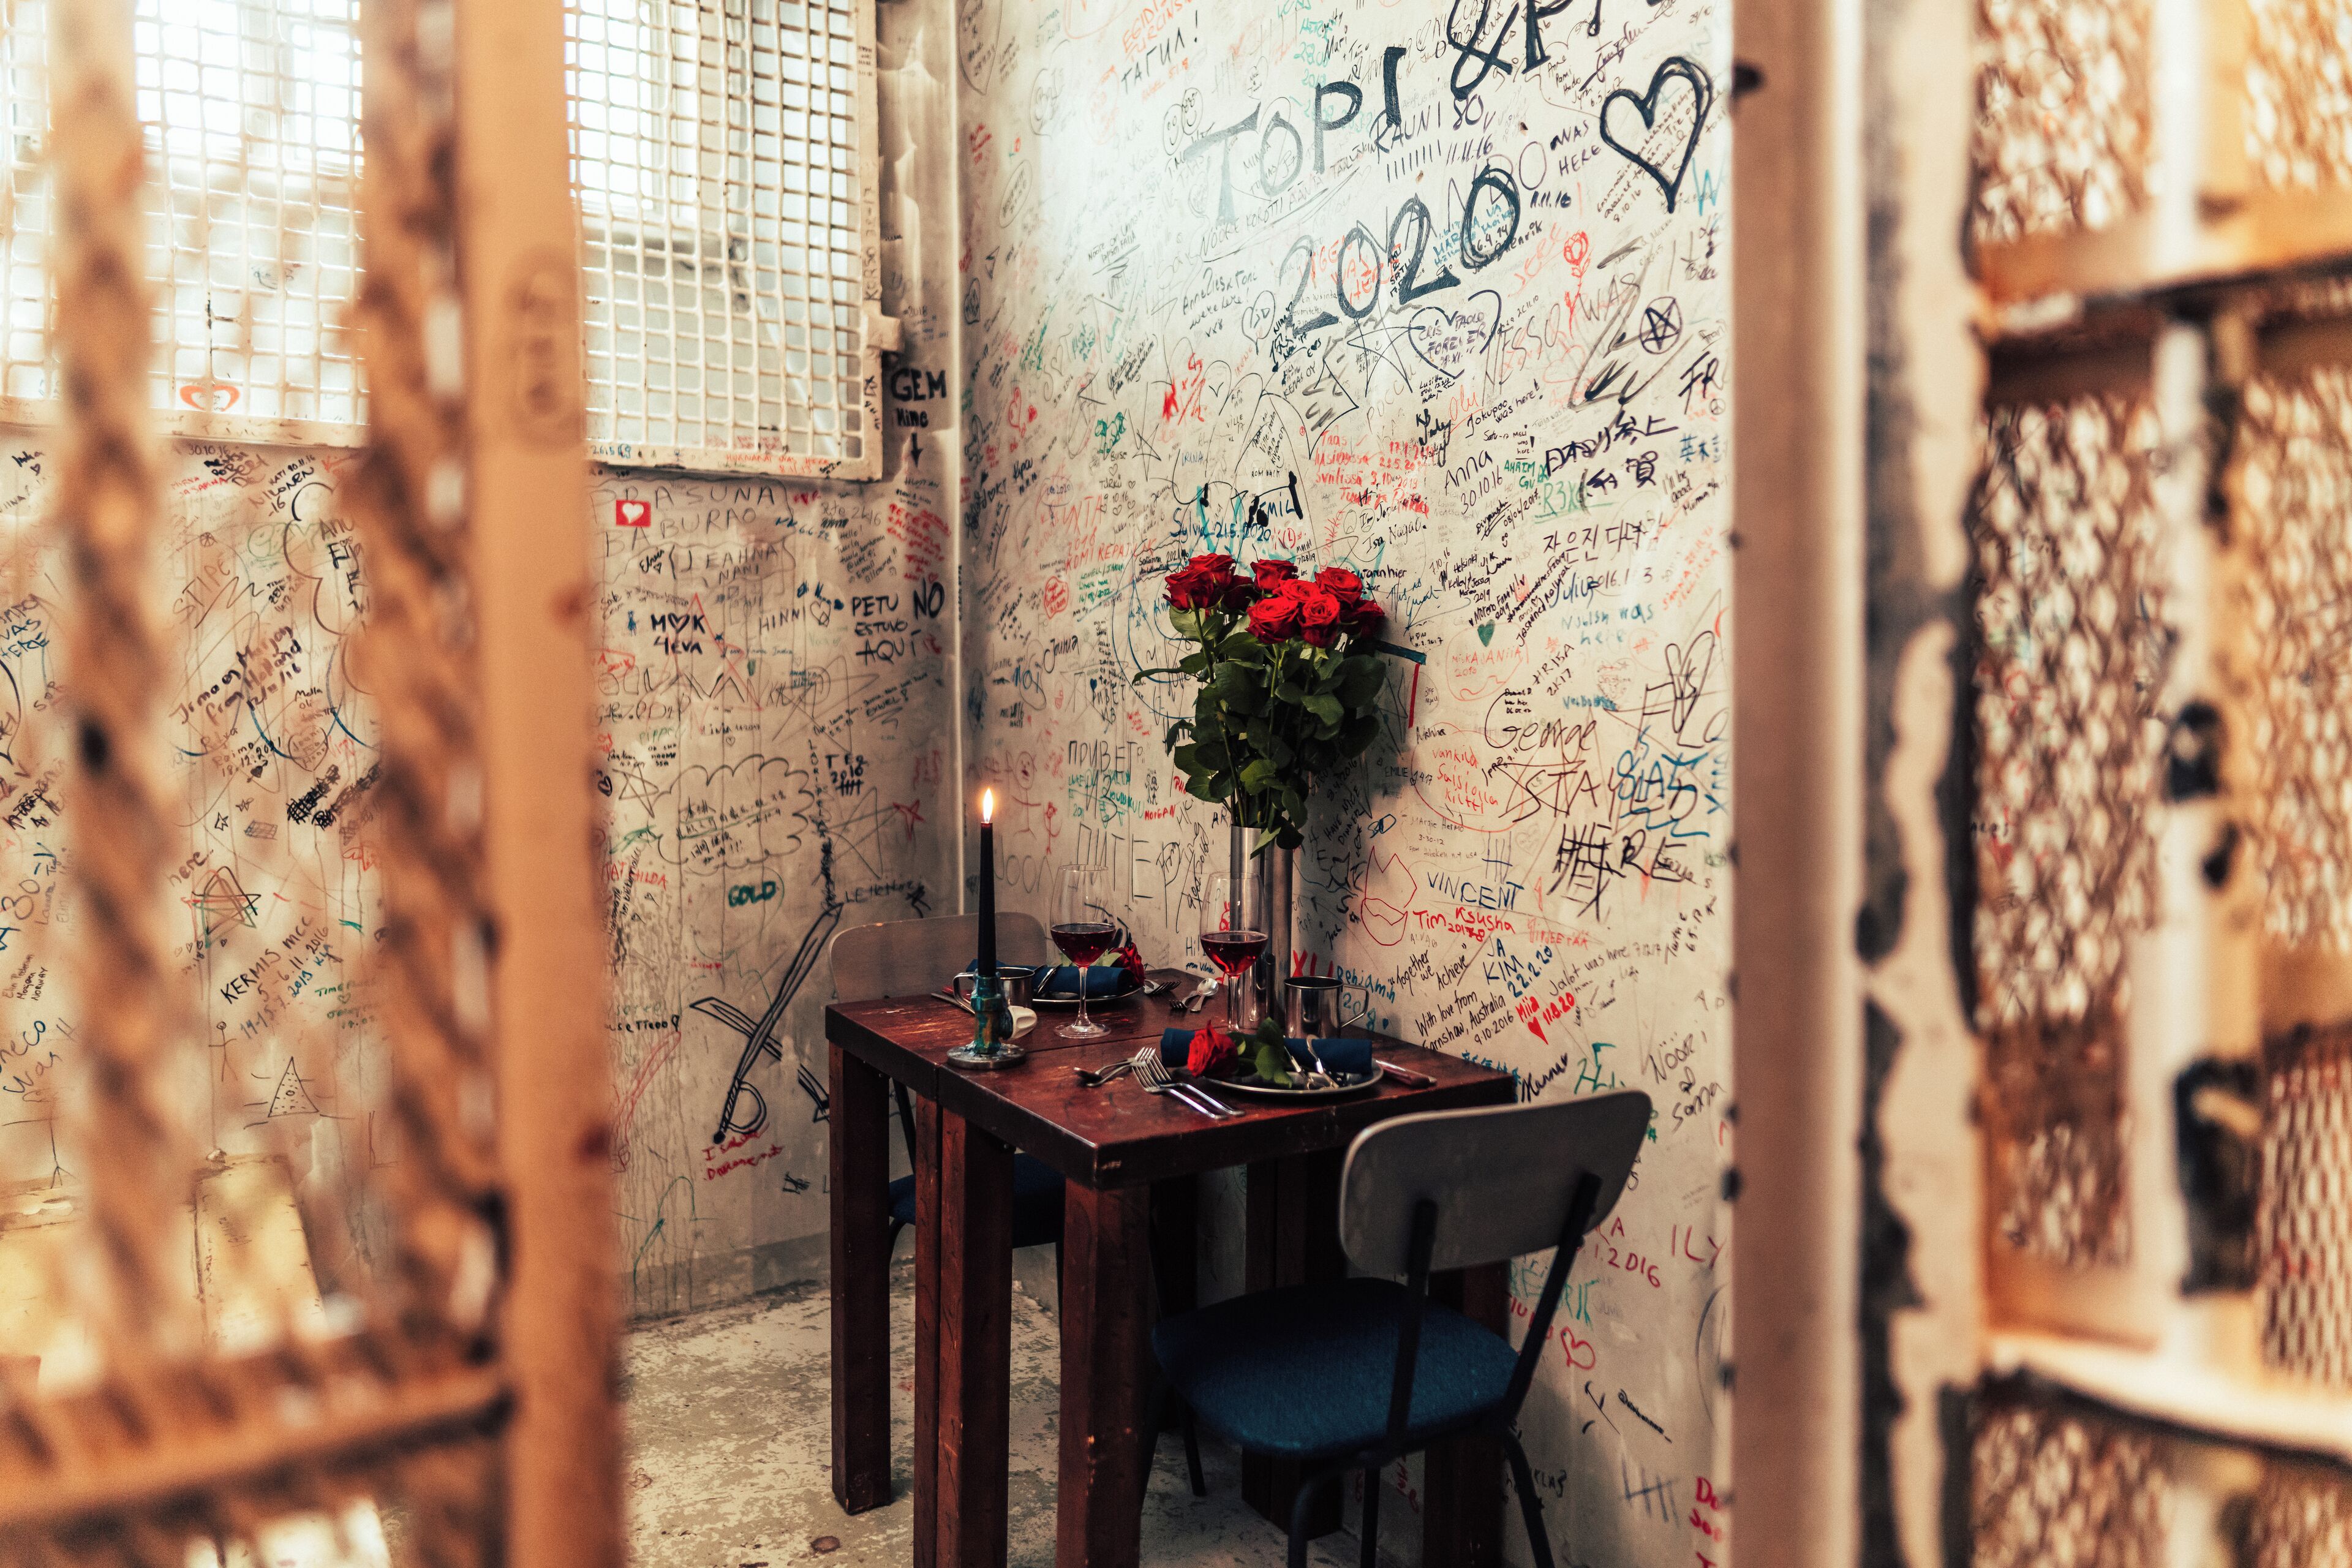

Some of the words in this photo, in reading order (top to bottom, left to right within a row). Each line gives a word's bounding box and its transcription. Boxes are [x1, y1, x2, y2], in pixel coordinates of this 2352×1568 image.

[1183, 46, 1407, 225] TOPI
[1558, 145, 1602, 177] HERE
[1278, 164, 1521, 337] 2020
[890, 368, 948, 402] GEM
[1495, 406, 1513, 424] was
[1445, 450, 1493, 496] Anna
[1387, 564, 1408, 579] hier
[1453, 554, 1477, 574] Helsinki
[851, 593, 899, 617] PETU
[913, 576, 945, 620] NO
[1473, 589, 1491, 603] 2019
[854, 618, 908, 636] ESTUVO
[1068, 738, 1139, 782] ПРИВЕТ
[728, 880, 777, 908] GOLD
[1427, 872, 1525, 910] VINCENT
[1412, 910, 1447, 930] Tim
[220, 948, 281, 1005] KERMIS
[1420, 964, 1435, 981] we
[1482, 954, 1525, 986] KIM
[1584, 956, 1605, 972] was
[1415, 1011, 1438, 1038] With
[1437, 1003, 1455, 1022] love
[1454, 989, 1478, 1015] from
[1469, 992, 1507, 1030] Australia
[1474, 1010, 1514, 1046] 9.10.2016
